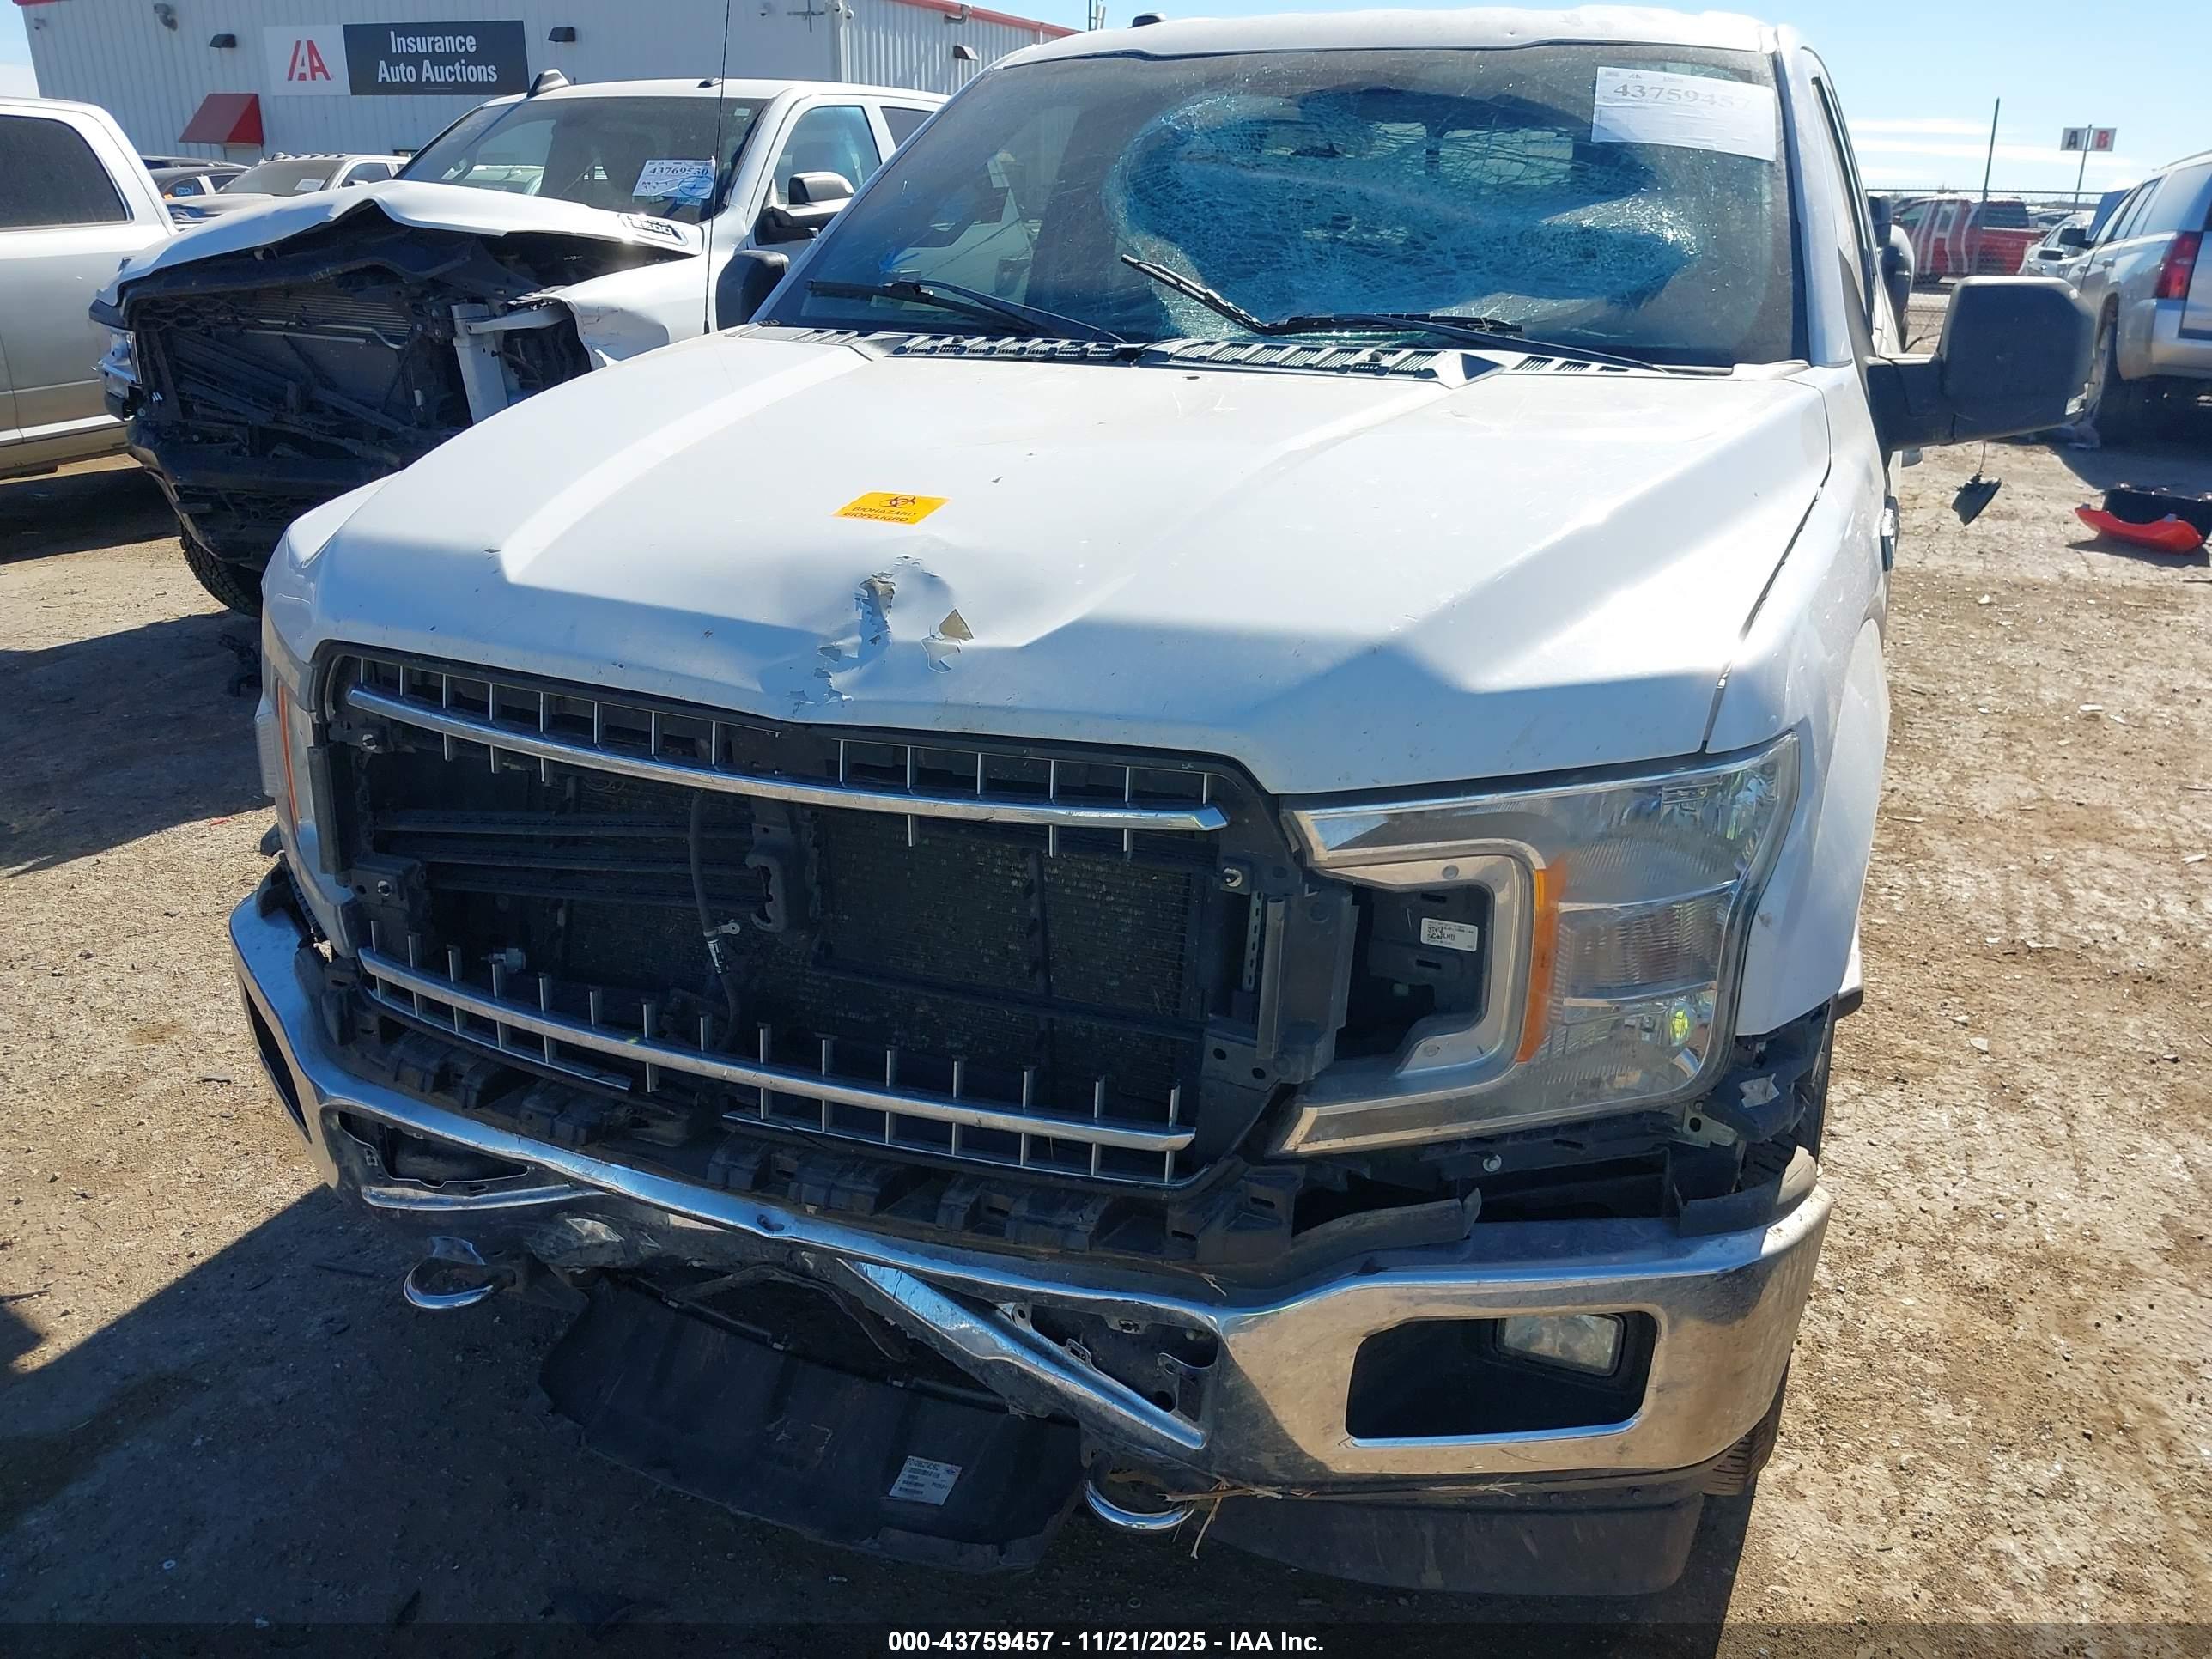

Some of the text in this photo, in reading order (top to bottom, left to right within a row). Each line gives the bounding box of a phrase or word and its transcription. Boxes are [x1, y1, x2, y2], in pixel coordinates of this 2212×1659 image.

[390, 31, 477, 53] Insurance
[377, 59, 498, 83] Auto Auctions
[1613, 83, 1753, 111] 43759457
[2066, 130, 2110, 149] A B
[851, 507, 917, 517] BIOHAZARD
